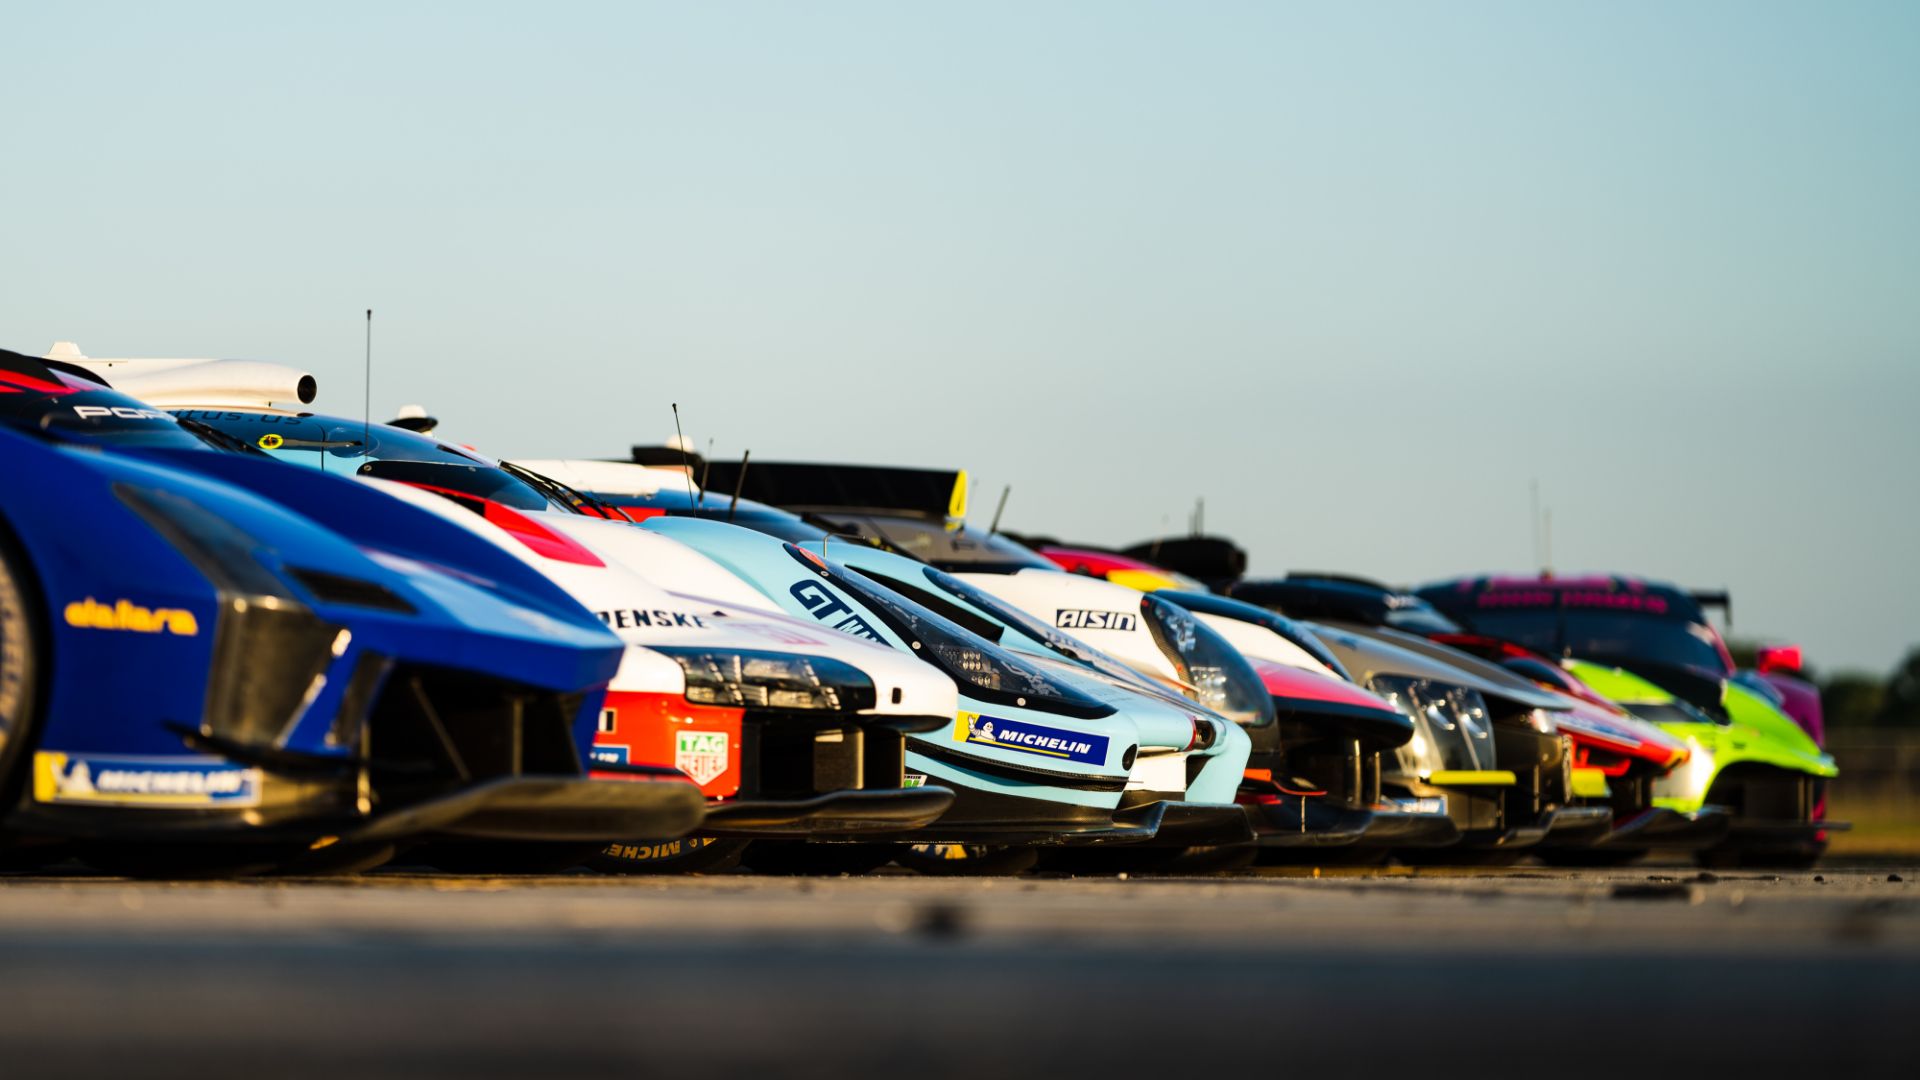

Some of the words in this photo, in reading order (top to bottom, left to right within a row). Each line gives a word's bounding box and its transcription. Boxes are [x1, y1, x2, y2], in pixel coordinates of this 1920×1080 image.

[789, 579, 853, 620] GT
[1057, 610, 1136, 631] AISIN
[681, 736, 725, 751] TAG
[1000, 729, 1092, 754] MICHELIN
[602, 840, 680, 859] MICHE
